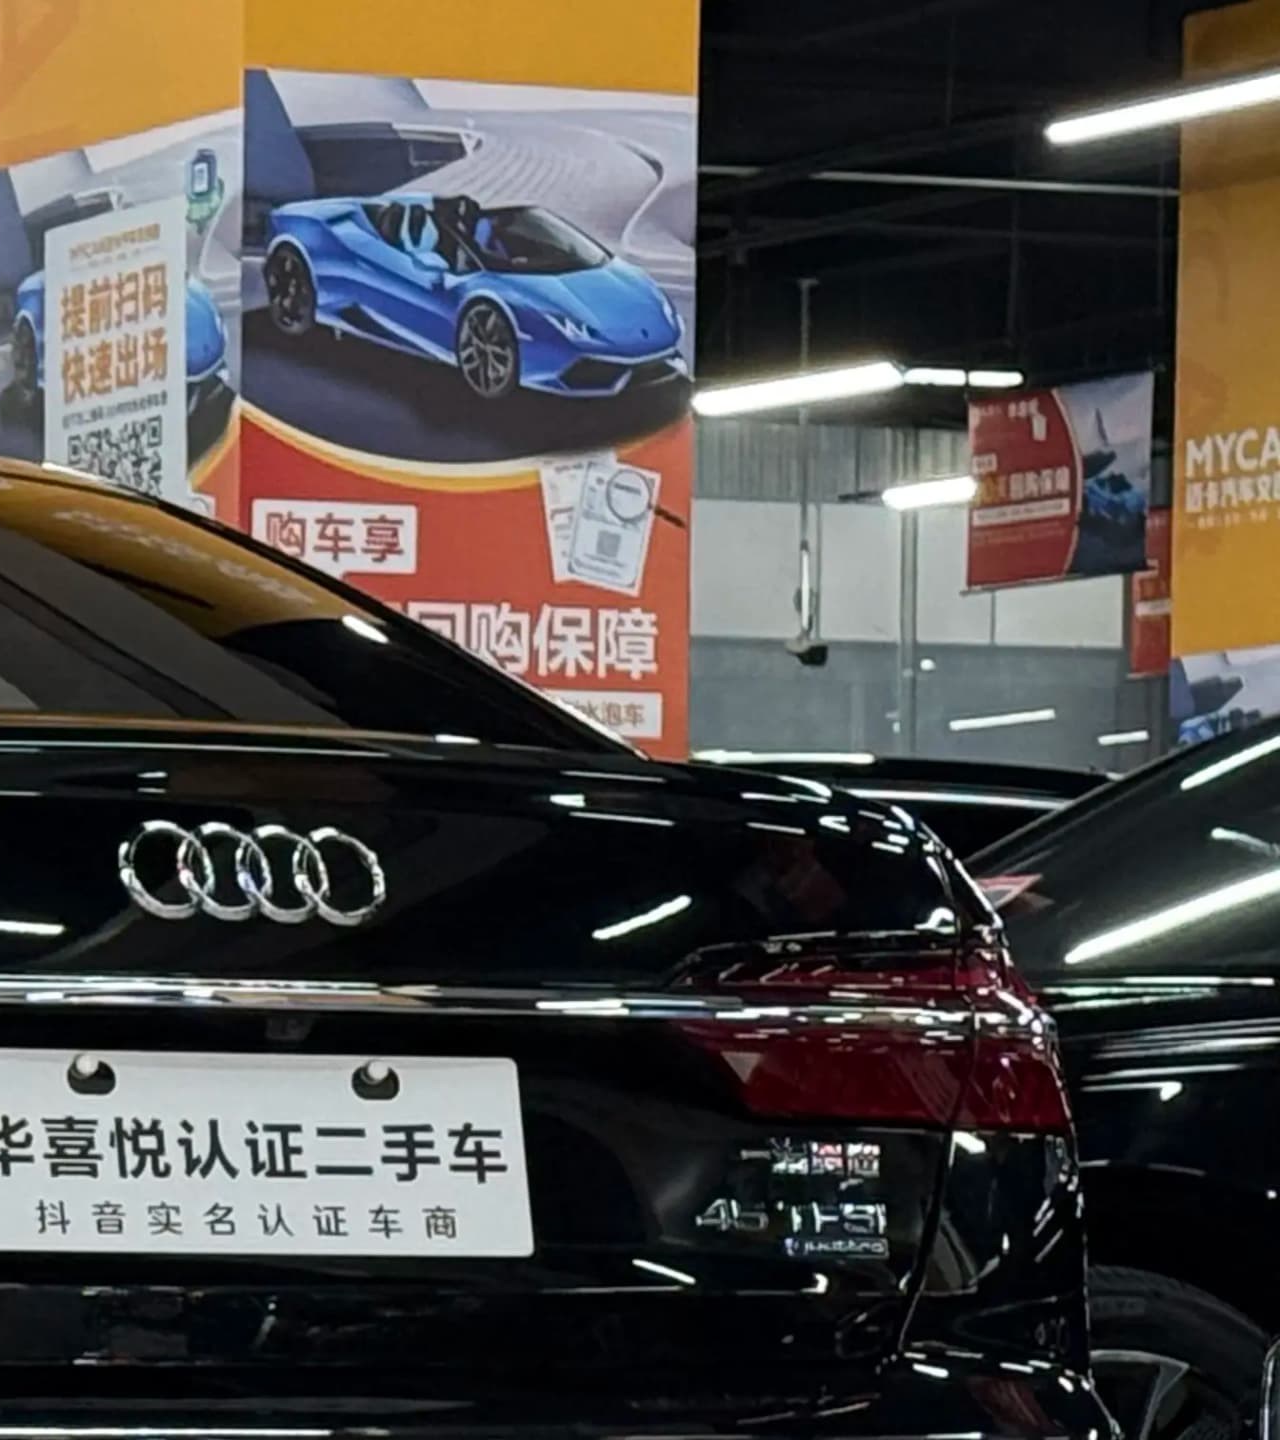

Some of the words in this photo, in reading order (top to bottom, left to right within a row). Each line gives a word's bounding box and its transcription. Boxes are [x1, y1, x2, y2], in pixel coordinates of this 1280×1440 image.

[61, 264, 168, 341] 提前扫码
[62, 327, 168, 404] 快速出场
[265, 511, 405, 563] 购车享
[36, 1199, 459, 1240] 抖音实名认证车商
